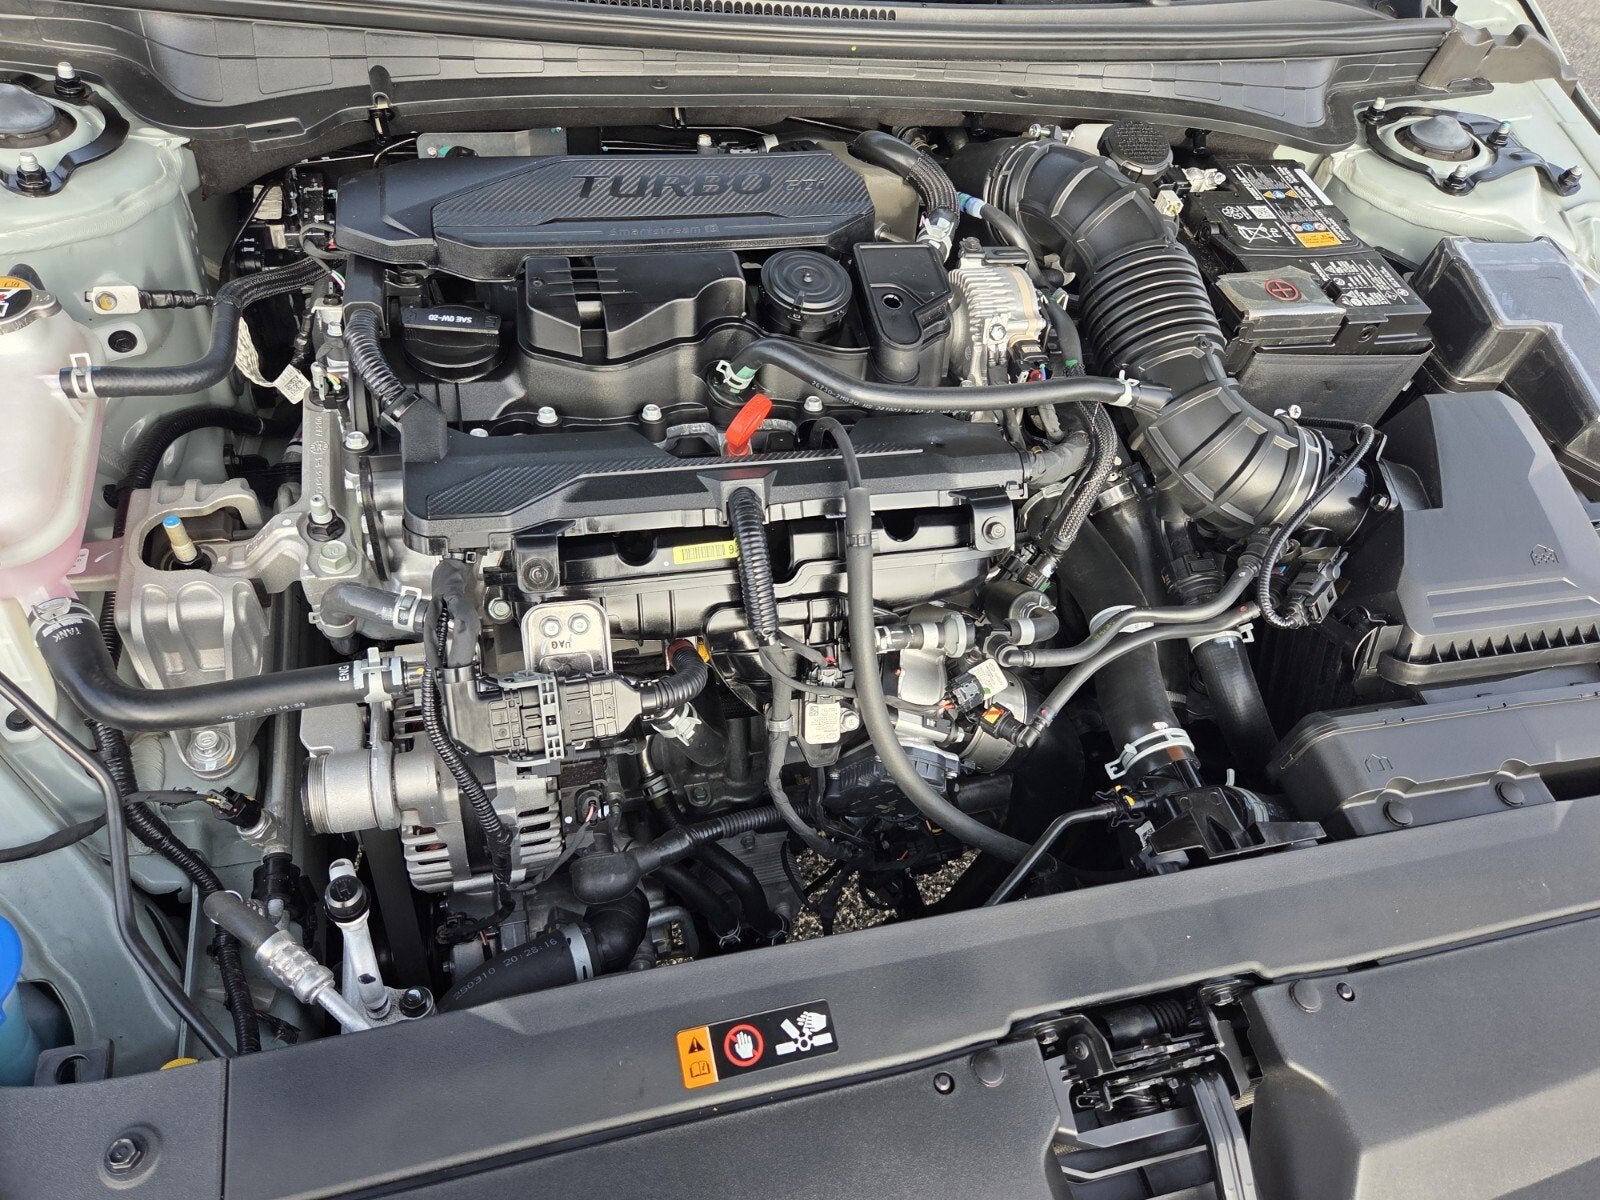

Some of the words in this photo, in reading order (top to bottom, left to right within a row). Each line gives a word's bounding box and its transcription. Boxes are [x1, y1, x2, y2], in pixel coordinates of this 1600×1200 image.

[571, 173, 772, 199] TURBO
[428, 314, 455, 323] 0W-20
[455, 315, 473, 324] SAE
[52, 626, 81, 643] TANK
[338, 664, 350, 682] ENG
[503, 938, 558, 967] 20:28:16
